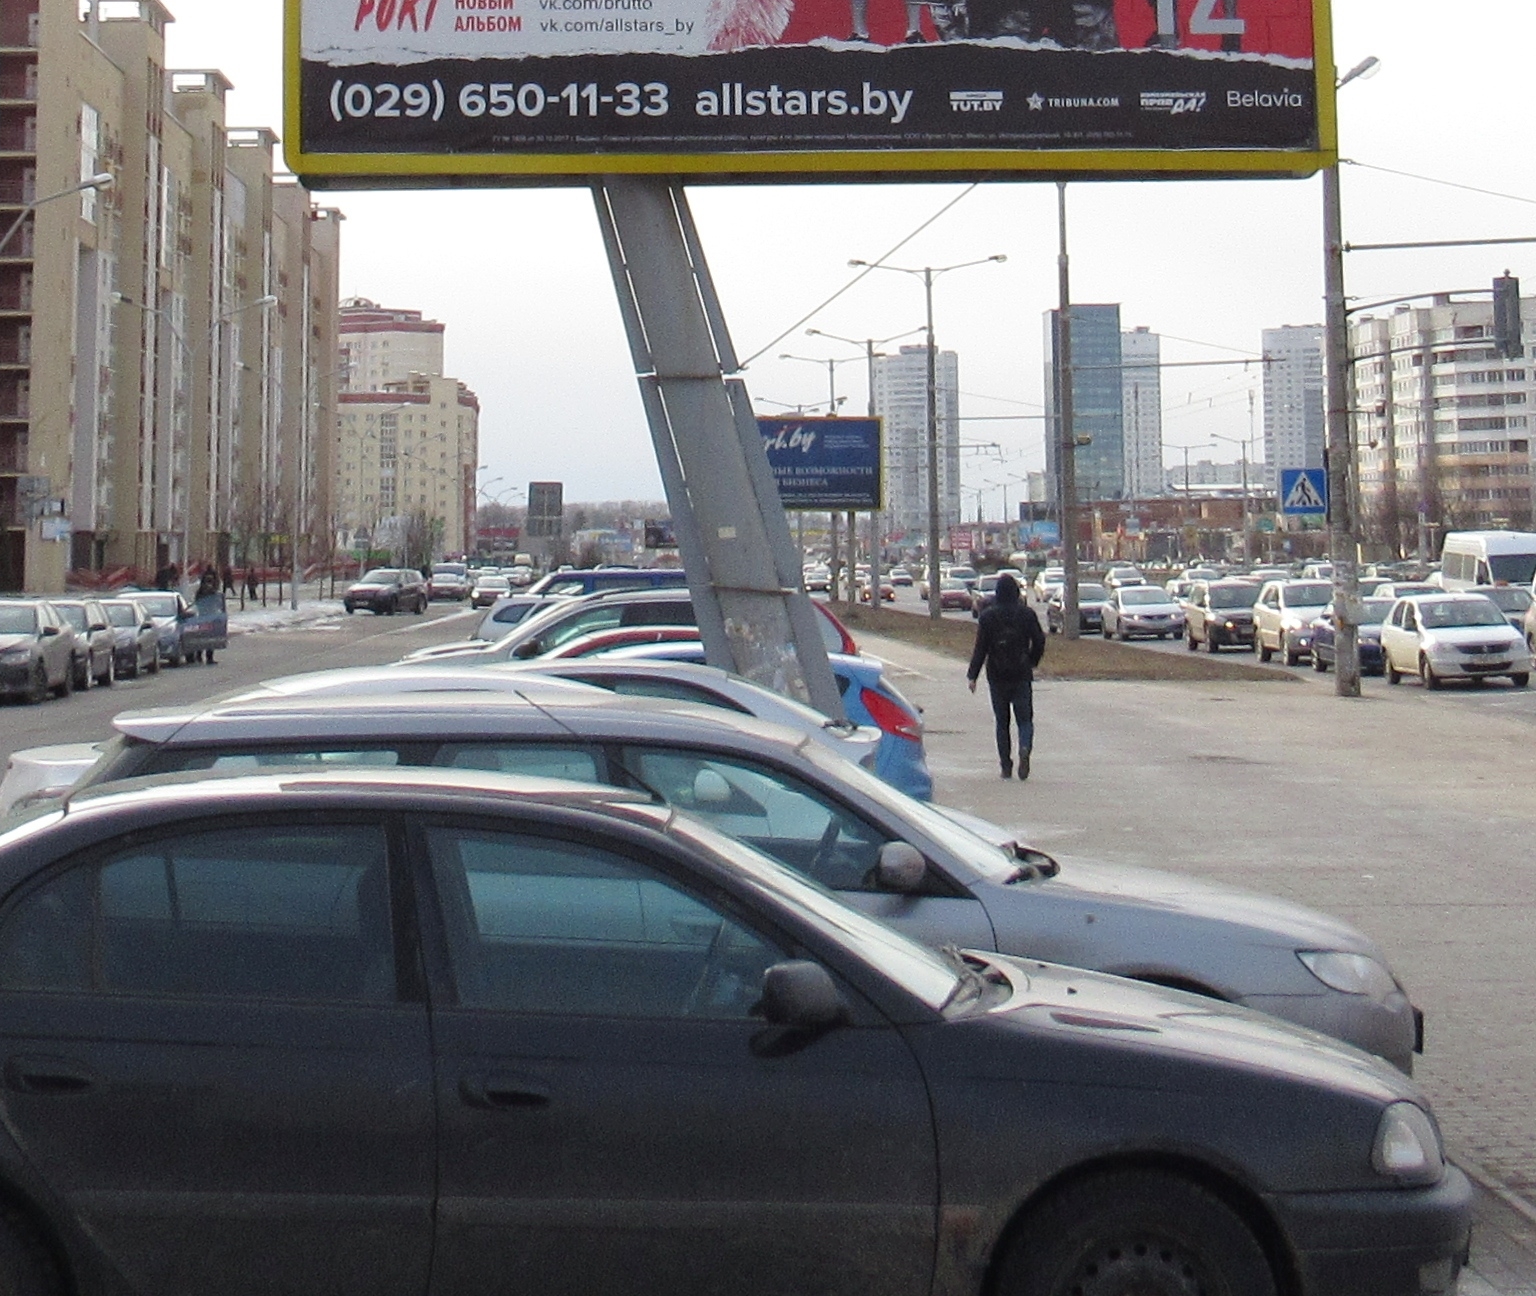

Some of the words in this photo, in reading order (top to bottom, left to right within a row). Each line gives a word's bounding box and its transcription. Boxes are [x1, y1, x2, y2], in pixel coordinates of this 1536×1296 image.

[454, 15, 522, 33] АЛЬБОМ
[540, 18, 695, 36] vk.com/allstars_by
[330, 79, 446, 122] (029)
[458, 82, 670, 117] 650-11-33
[695, 81, 914, 124] allstars.by
[950, 100, 1003, 112] TUT.BY
[1047, 97, 1121, 108] TRIBUNA.COM
[1226, 88, 1303, 108] Belavia
